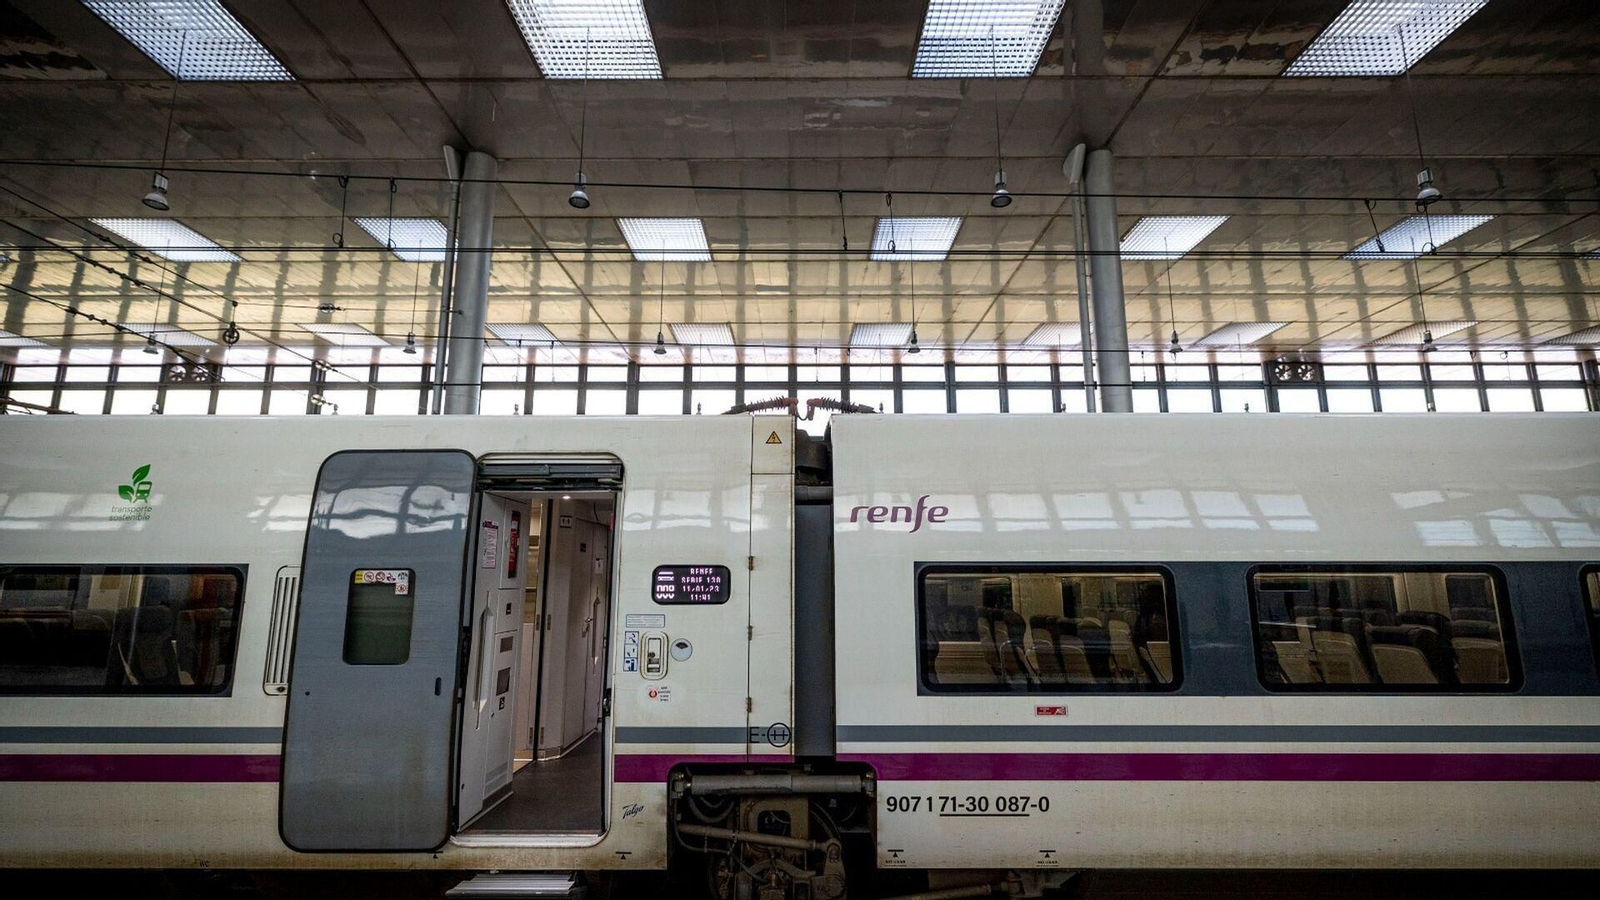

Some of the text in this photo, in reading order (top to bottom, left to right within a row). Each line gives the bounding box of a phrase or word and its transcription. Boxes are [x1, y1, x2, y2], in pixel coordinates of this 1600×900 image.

[112, 506, 152, 514] transporte
[850, 494, 949, 533] renfe
[622, 803, 645, 819] Talgo
[886, 796, 1050, 812] 907 1 71-30 087-0
